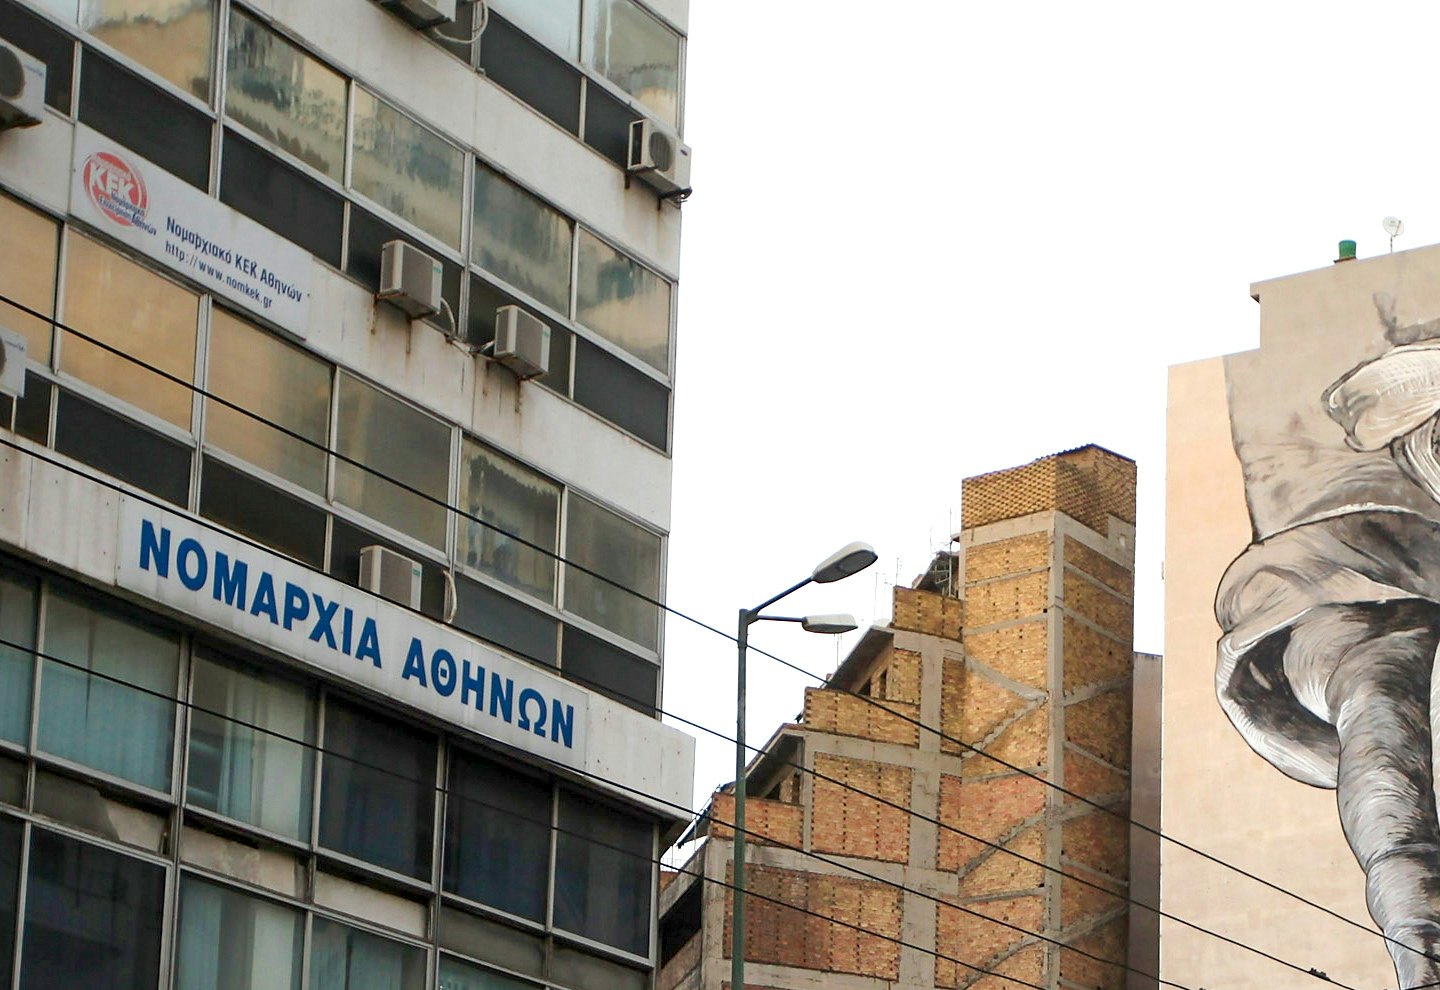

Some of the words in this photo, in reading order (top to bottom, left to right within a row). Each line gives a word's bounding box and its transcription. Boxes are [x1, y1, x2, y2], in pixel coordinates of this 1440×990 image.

[165, 240, 273, 309] http://www.nomkek.gr
[166, 216, 231, 264] Νομαρχιακό
[235, 253, 258, 279] ΚΕΚ
[260, 268, 302, 303] Αθηνών
[139, 519, 382, 669] ΝΟΜΑΡΧΙΑ
[401, 637, 575, 749] ΑΘΗΝΩΝ
